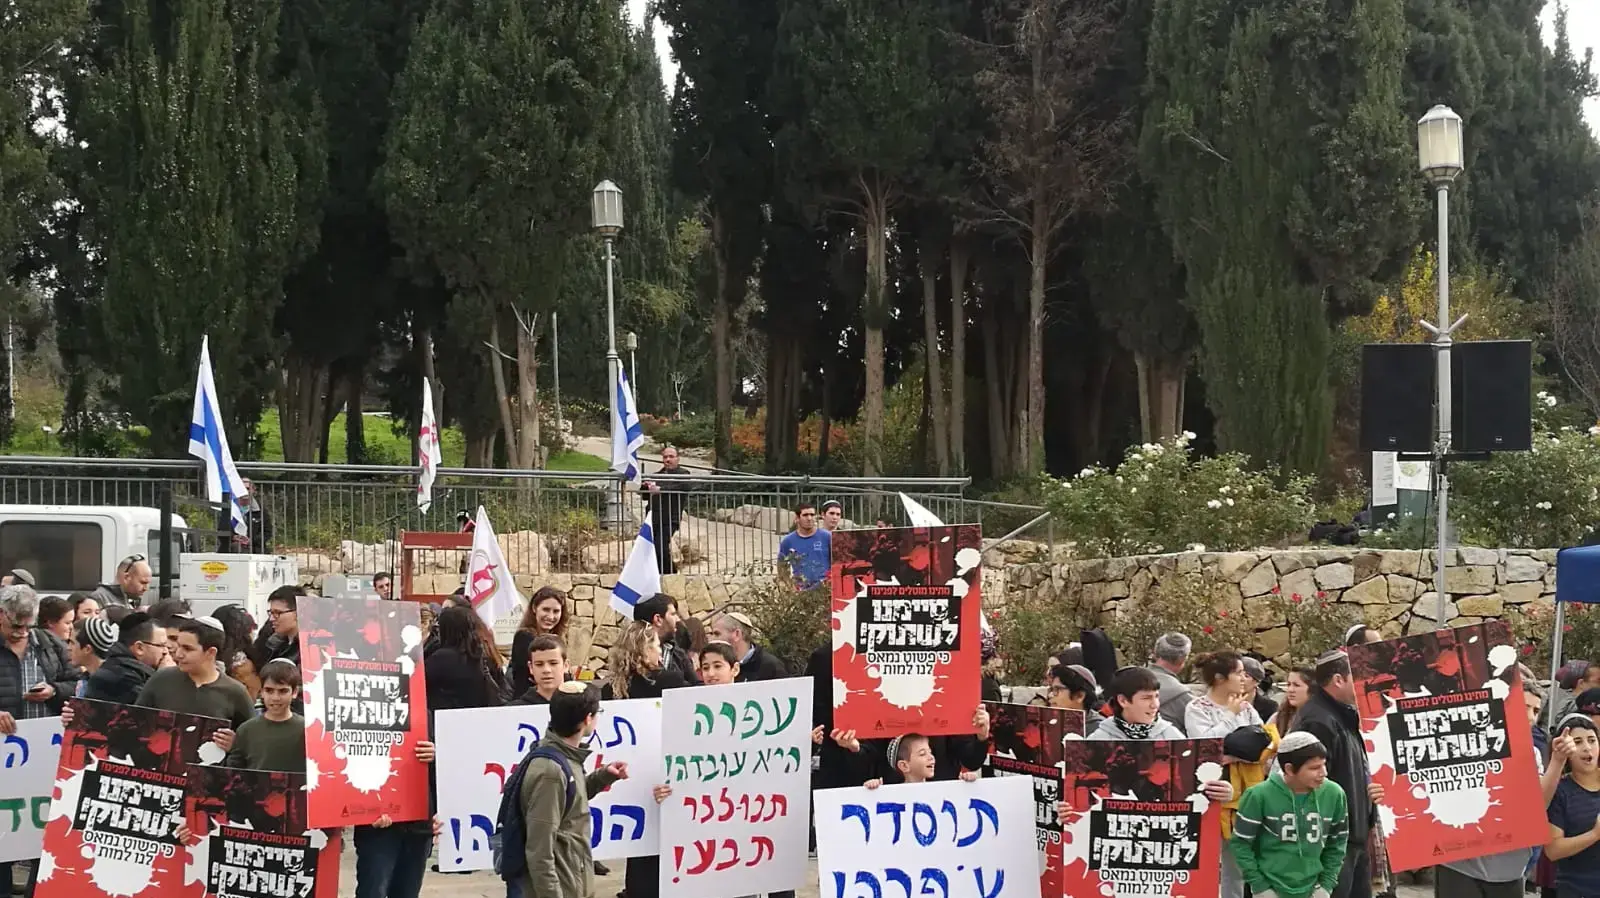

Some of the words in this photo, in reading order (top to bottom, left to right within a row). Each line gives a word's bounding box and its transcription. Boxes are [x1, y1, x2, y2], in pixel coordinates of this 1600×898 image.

[872, 599, 949, 621] סיימנו
[860, 619, 959, 651] לשתוק!
[868, 652, 900, 663] נמאס
[903, 652, 936, 665] פשוט
[939, 652, 950, 663] כי
[883, 662, 913, 675] למות
[916, 663, 934, 675] לנו
[336, 673, 400, 699] סיימנו
[327, 696, 409, 729] לשתוק!
[694, 697, 798, 740] עפרה
[1403, 703, 1491, 737] סיימנו
[335, 731, 362, 742] נמאס
[365, 731, 391, 744] פשוט
[394, 733, 403, 744] כי
[349, 743, 373, 756] למות
[376, 743, 390, 756] לנו
[1396, 724, 1506, 771] לשתוק!
[752, 747, 801, 773] היא
[1488, 761, 1501, 772] כי
[665, 751, 747, 785] עובדה!
[1410, 767, 1446, 782] נמאס
[1449, 762, 1485, 779] פשוט
[1430, 779, 1461, 793] למות
[1466, 775, 1485, 789] לנו
[98, 775, 184, 811] סיימנו
[80, 797, 187, 839] לשתוק!
[841, 798, 999, 847] תוסדר
[1106, 813, 1189, 839] סיימנו
[84, 830, 120, 847] נמאס
[123, 837, 159, 854] פשוט
[97, 846, 132, 863] למות
[162, 844, 174, 857] כי
[224, 839, 305, 872] סיימנו
[1093, 836, 1198, 869] לשתוק!
[135, 852, 154, 866] לנו
[211, 861, 314, 898] לשתוק!
[1101, 870, 1136, 881] נמאס
[1140, 870, 1173, 884] פשוט
[1177, 871, 1188, 881] כי
[1117, 882, 1149, 894] למות
[1153, 882, 1170, 895] לנו
